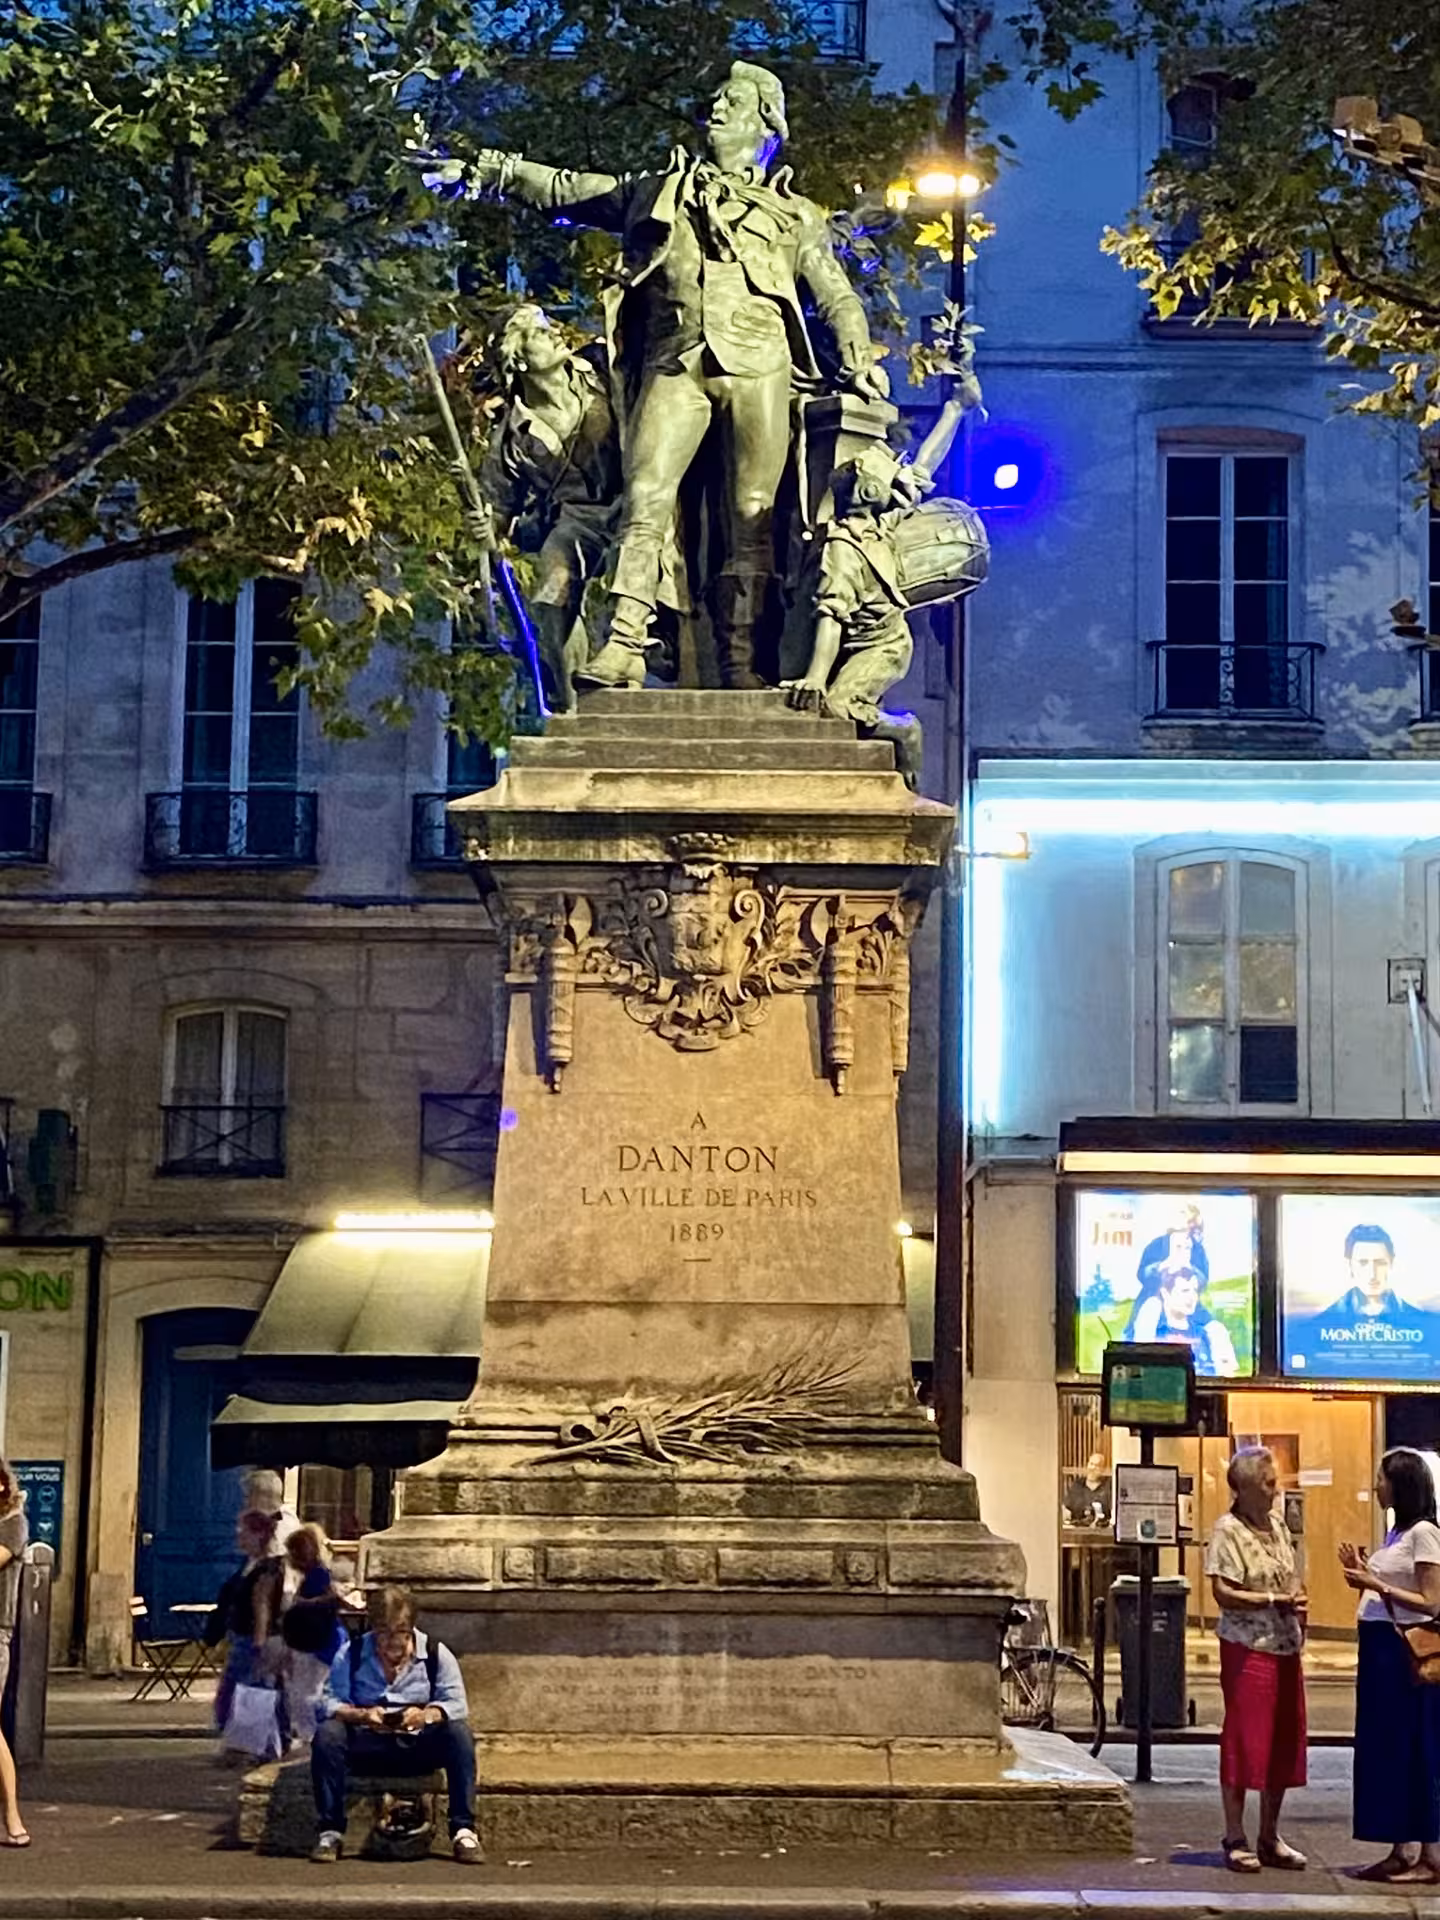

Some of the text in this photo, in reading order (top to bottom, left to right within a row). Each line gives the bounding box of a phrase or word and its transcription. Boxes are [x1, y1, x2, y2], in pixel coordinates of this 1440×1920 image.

[690, 1111, 707, 1130] A
[617, 1145, 779, 1172] DANTON
[580, 1186, 818, 1208] LA VILLE DE PARIS
[669, 1223, 724, 1242] 1889
